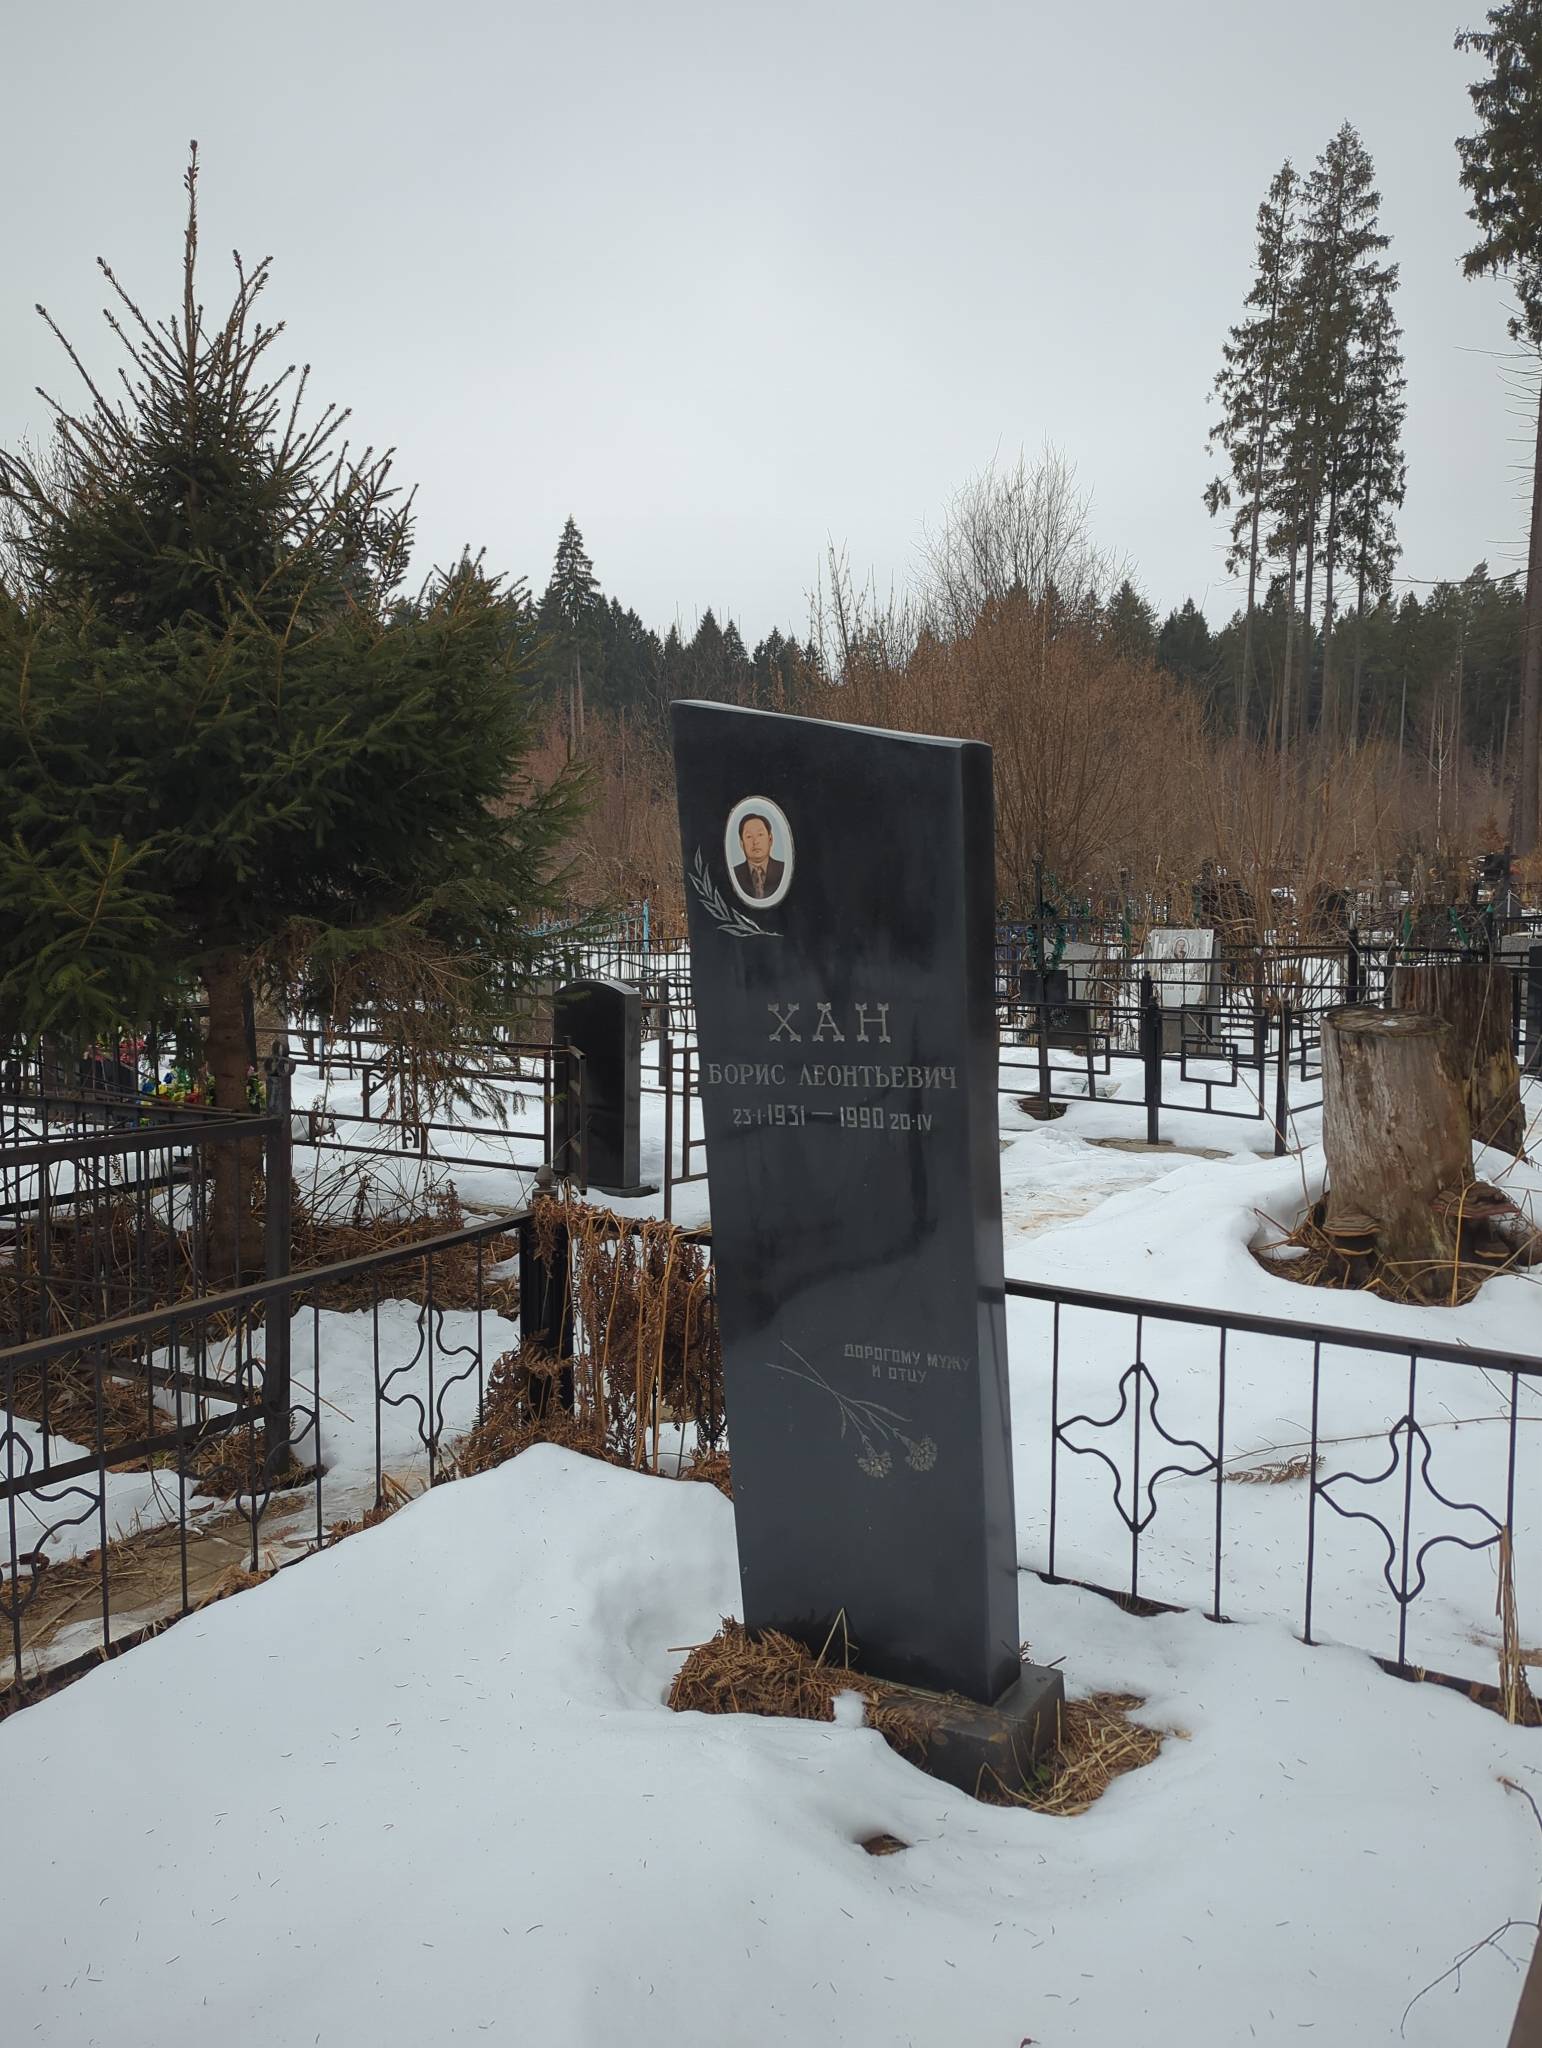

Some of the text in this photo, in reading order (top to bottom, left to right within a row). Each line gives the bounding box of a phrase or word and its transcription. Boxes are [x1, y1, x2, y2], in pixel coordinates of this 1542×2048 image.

[767, 1002, 892, 1043] ХАН
[707, 1063, 959, 1089] БОРИС ЛЕОНТЬЕВИЧ
[839, 1106, 884, 1129] 1990
[844, 1343, 971, 1371] ДОРОГОМУ МУЖУ
[872, 1364, 927, 1383] И ОТЦУ
